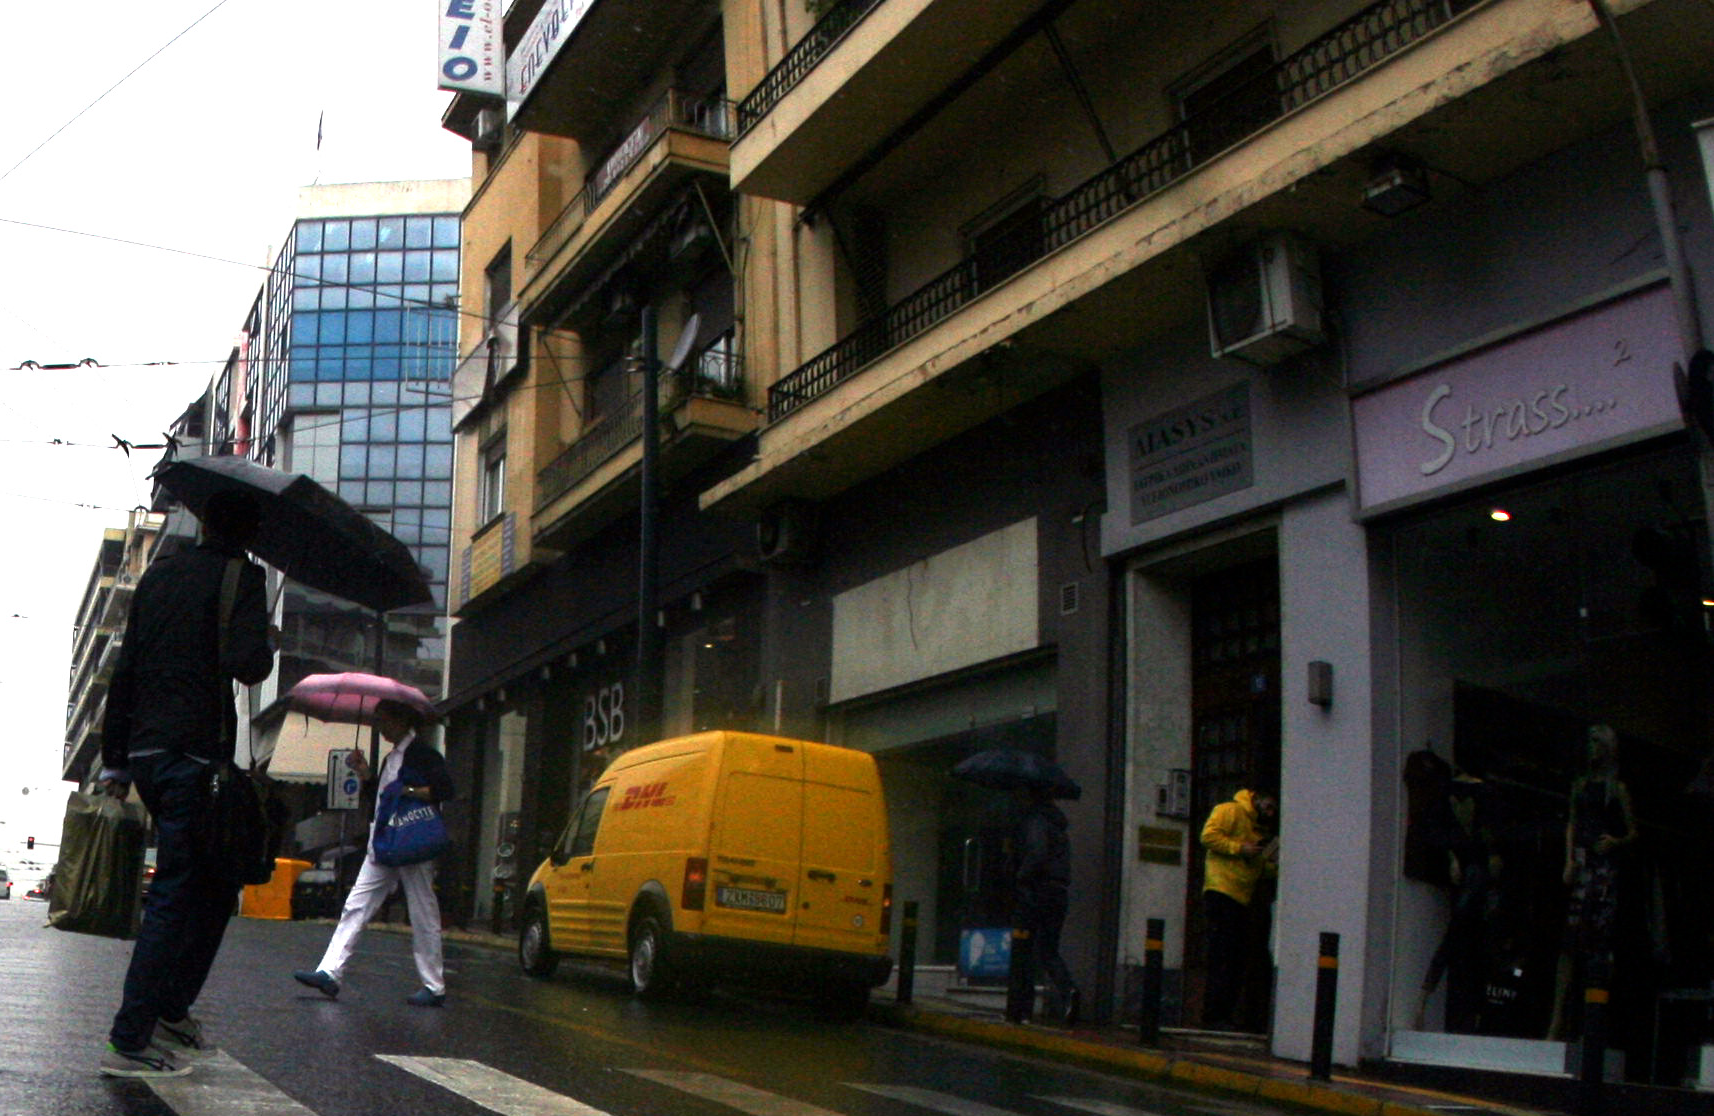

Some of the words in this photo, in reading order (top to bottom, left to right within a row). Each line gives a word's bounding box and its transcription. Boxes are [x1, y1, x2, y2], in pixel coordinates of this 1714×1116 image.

[1613, 339, 1633, 367] 2
[583, 682, 624, 751] BSB
[619, 782, 671, 811] DHL
